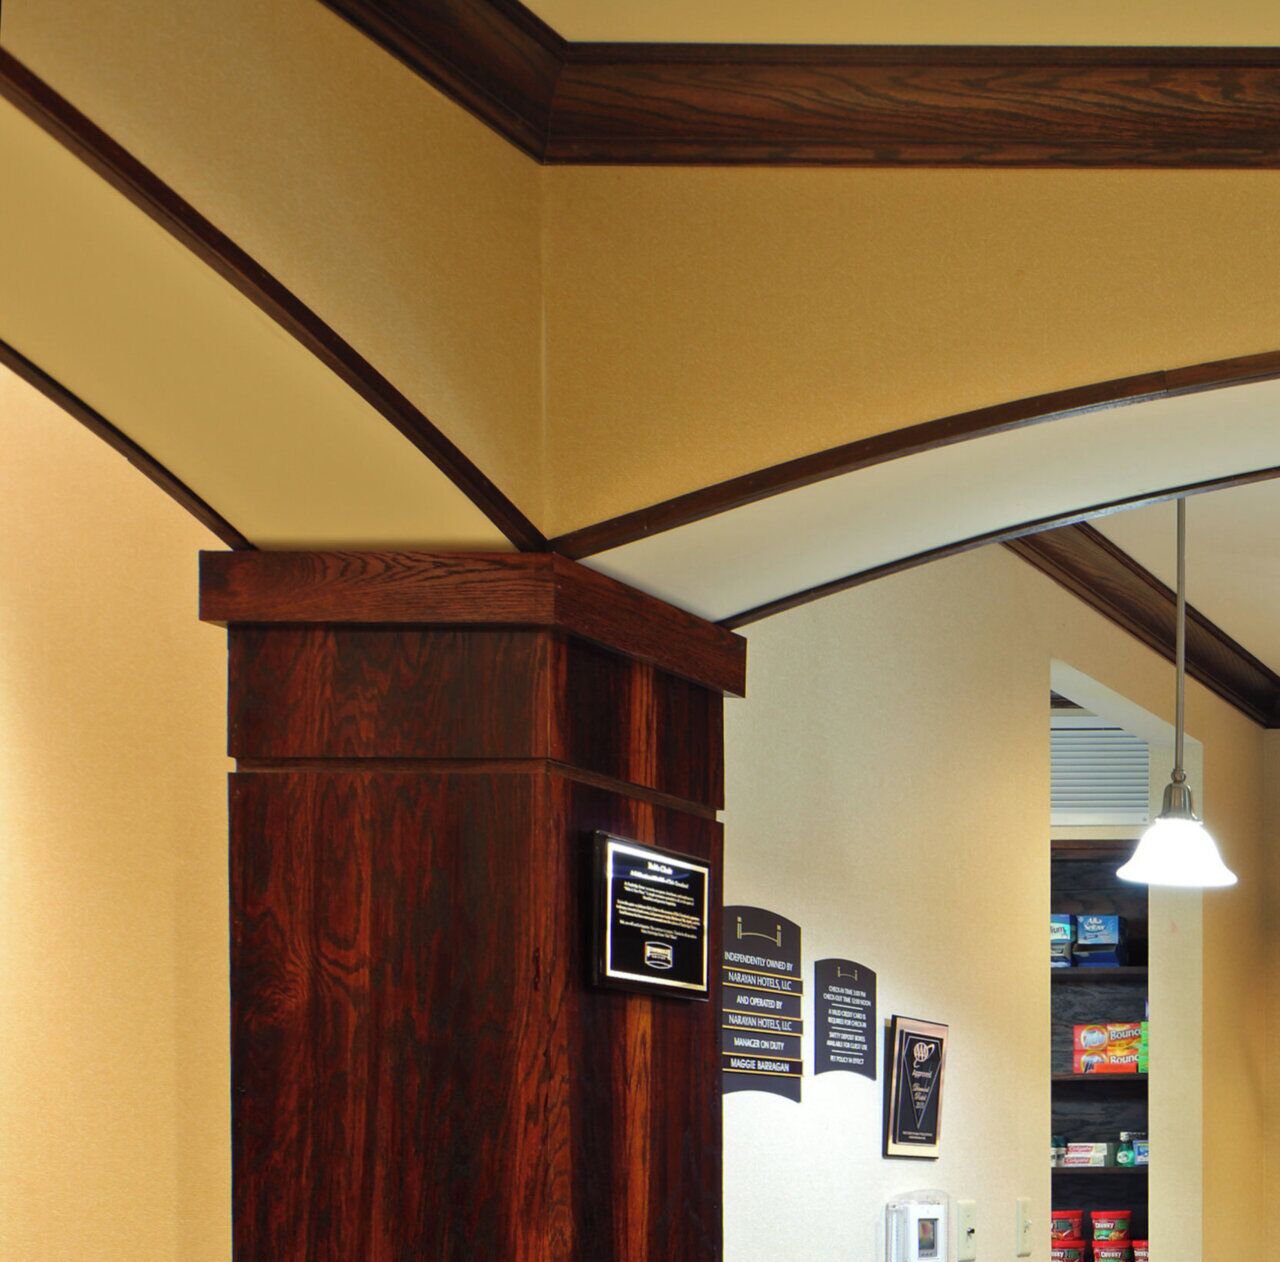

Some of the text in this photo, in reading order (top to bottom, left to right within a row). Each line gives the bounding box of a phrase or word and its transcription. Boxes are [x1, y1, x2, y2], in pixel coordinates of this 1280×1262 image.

[724, 951, 793, 971] INDEPENDENTLY OWNED BY
[728, 972, 792, 990] NARAYAN HOTELS, LLC
[736, 995, 783, 1010] AND OPERATED BY
[728, 1014, 792, 1031] NARAYAN HOTELS, LLC
[1110, 1028, 1141, 1040] Bounc
[734, 1037, 784, 1050] MANAGER ON DUTY
[730, 1058, 790, 1072] MAGGIE BARRAGAN
